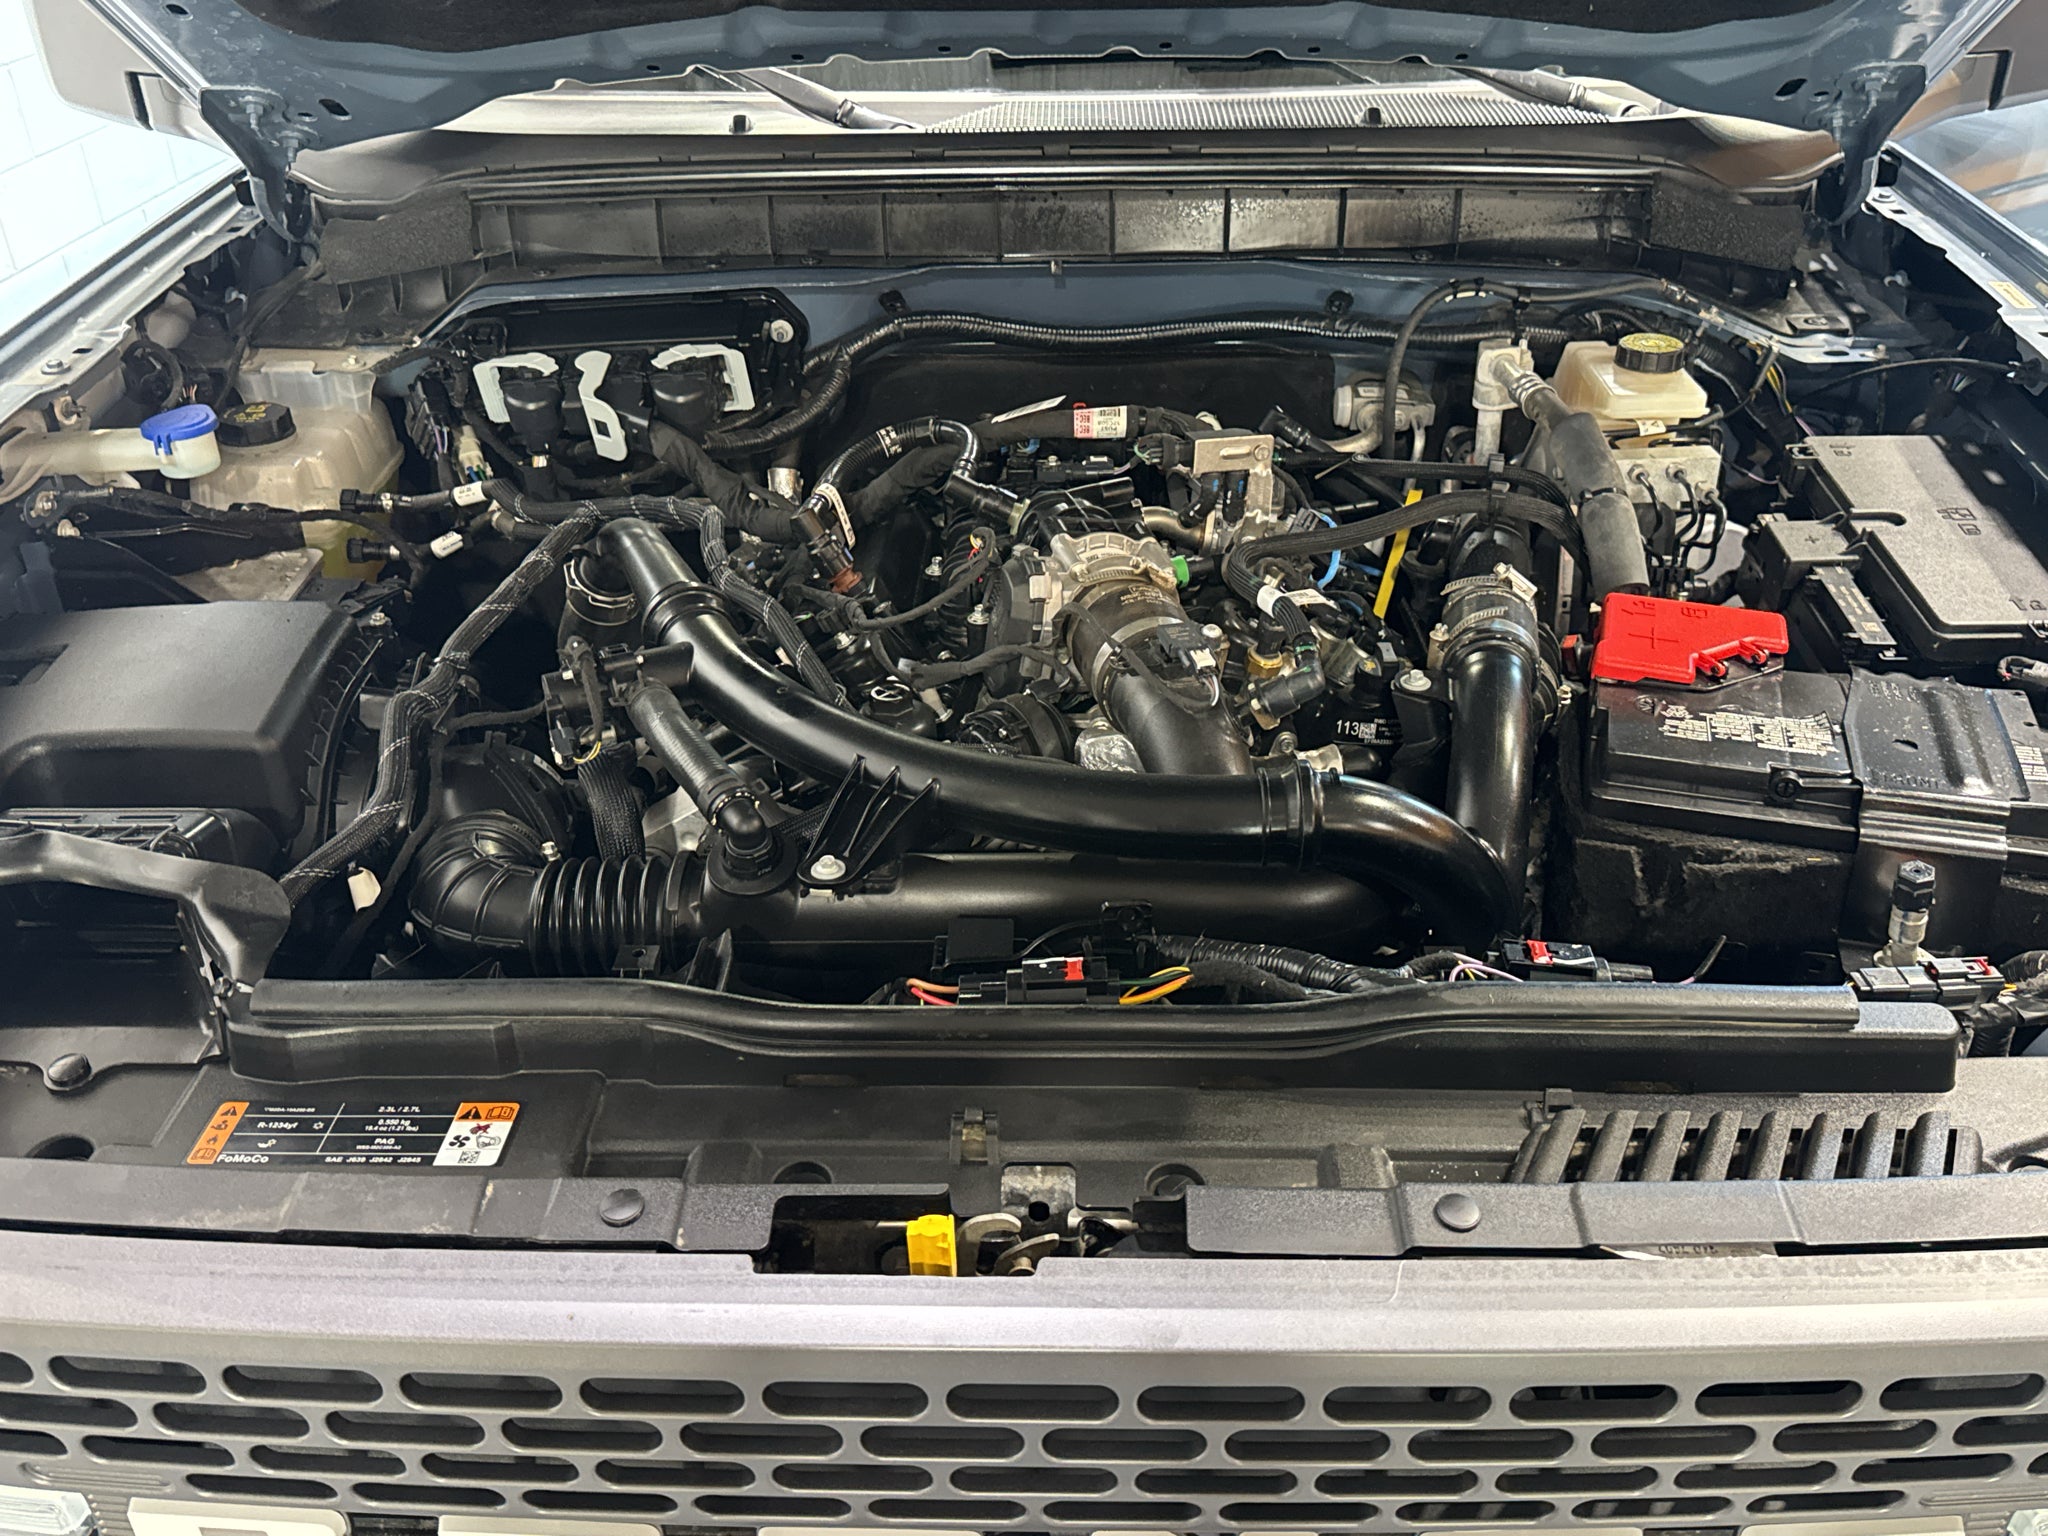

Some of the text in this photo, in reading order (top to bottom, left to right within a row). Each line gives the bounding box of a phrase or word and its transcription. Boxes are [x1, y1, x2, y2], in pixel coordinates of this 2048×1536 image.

[1336, 719, 1360, 735] 113
[257, 1121, 298, 1130] R-1234yf
[374, 1137, 396, 1145] PAG
[216, 1154, 269, 1163] FoMoCo
